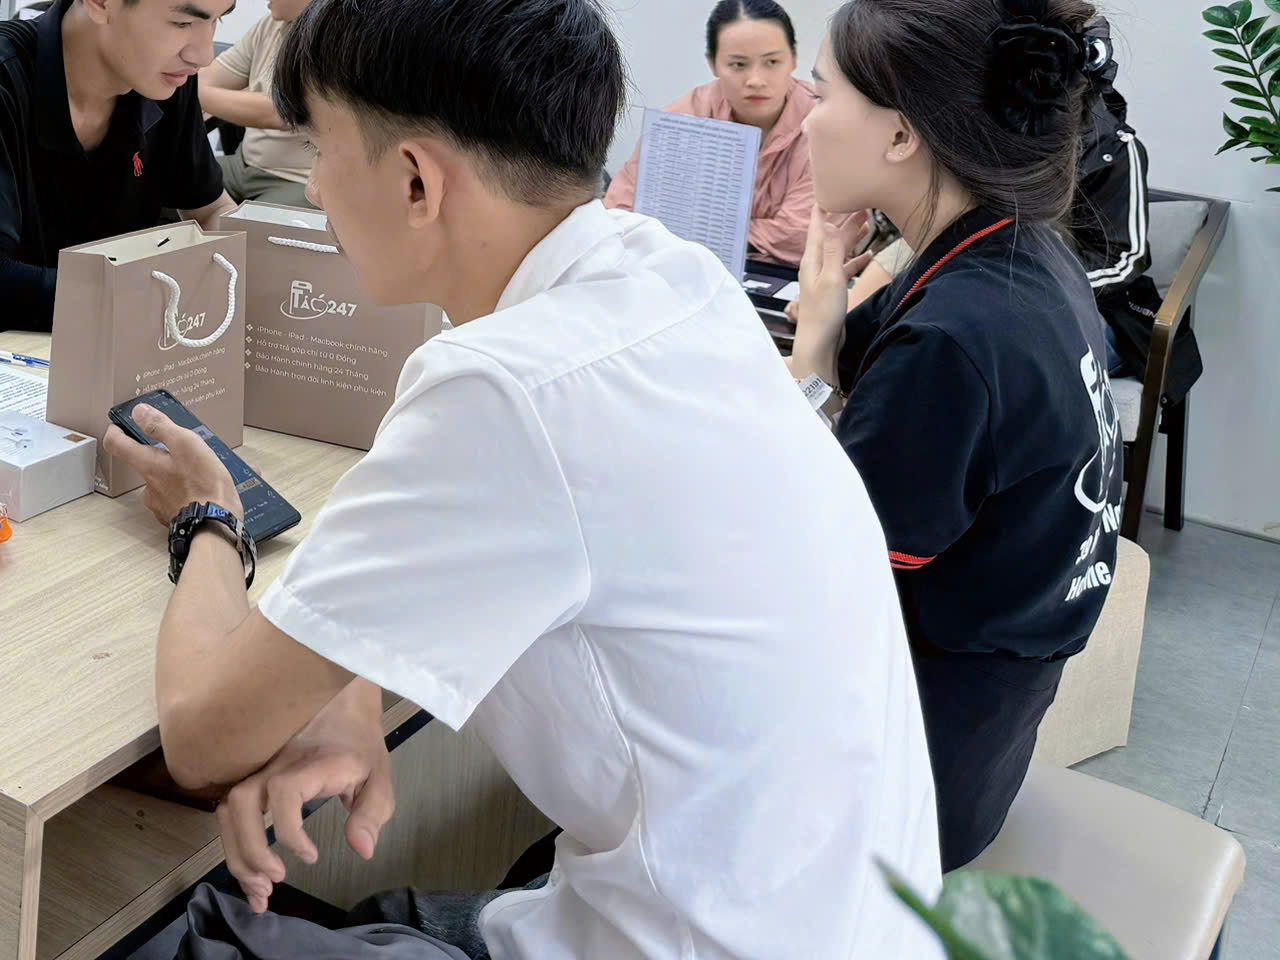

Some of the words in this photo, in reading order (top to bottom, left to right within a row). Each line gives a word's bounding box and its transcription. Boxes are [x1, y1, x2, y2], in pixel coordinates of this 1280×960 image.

[257, 326, 282, 337] iPhone
[288, 331, 304, 341] iPad
[310, 335, 344, 348] Macbook
